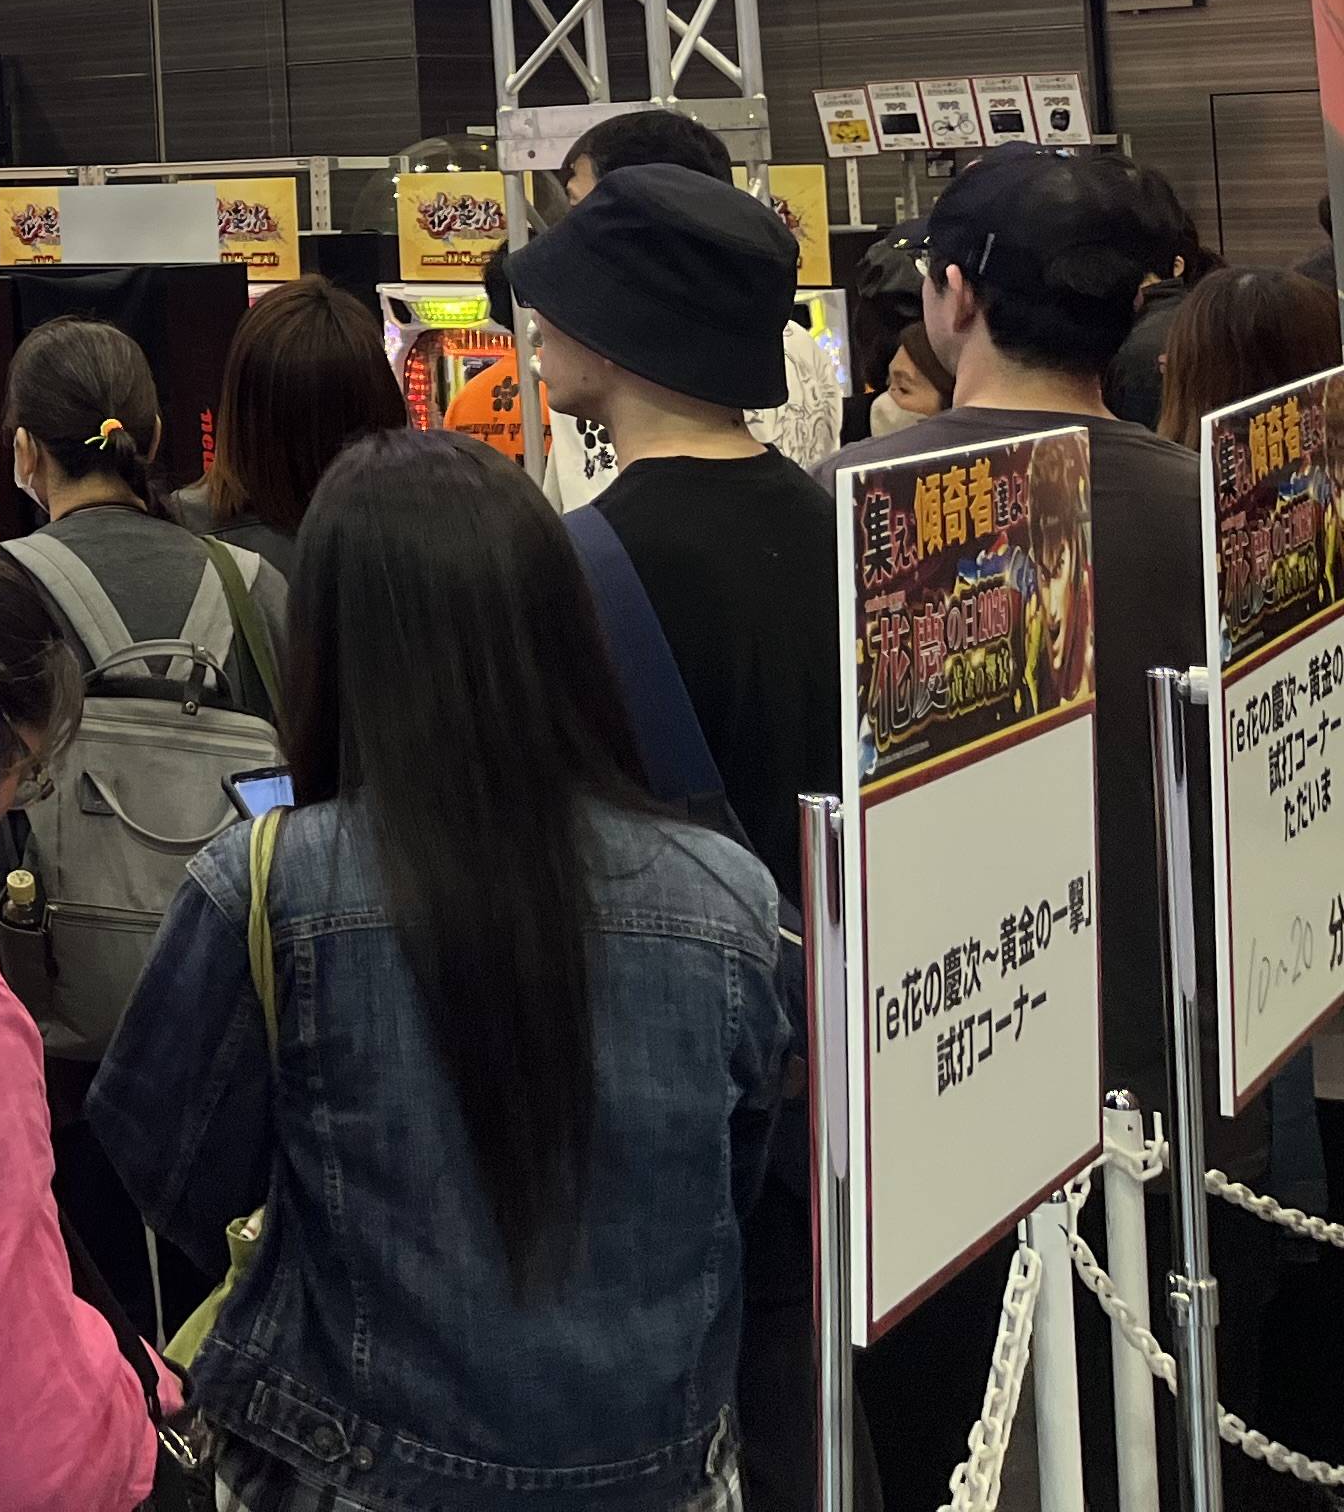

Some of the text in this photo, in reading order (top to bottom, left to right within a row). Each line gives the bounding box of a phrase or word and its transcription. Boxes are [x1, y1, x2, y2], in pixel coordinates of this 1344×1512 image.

[1268, 709, 1342, 797] 試打コーナー
[1284, 766, 1332, 843] ただいま
[936, 984, 1047, 1097] 試打コーナー
